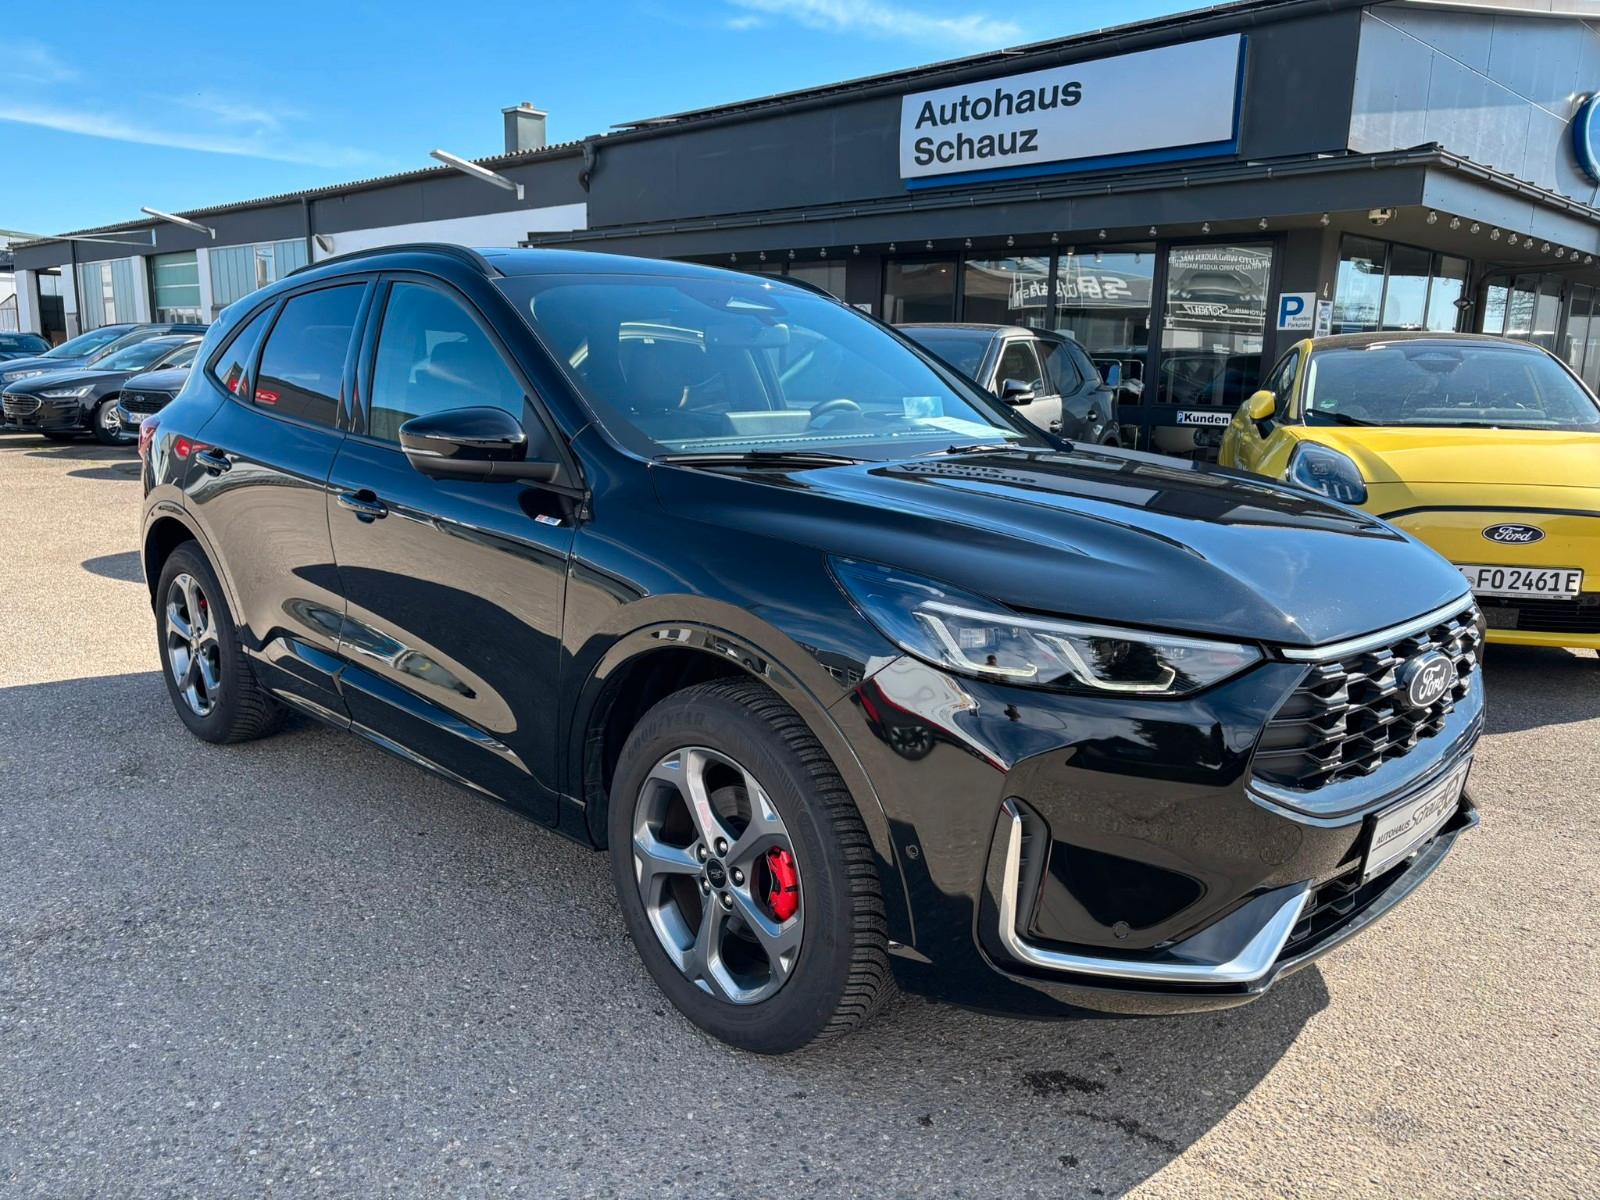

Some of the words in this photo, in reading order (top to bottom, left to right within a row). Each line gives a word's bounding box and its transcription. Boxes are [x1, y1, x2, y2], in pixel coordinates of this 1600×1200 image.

[915, 81, 1082, 129] Autohaus
[914, 129, 1039, 166] Schauz
[1279, 296, 1304, 328] P
[1184, 413, 1229, 424] Kunden
[1494, 527, 1533, 541] Ford
[1419, 664, 1447, 700] Ford
